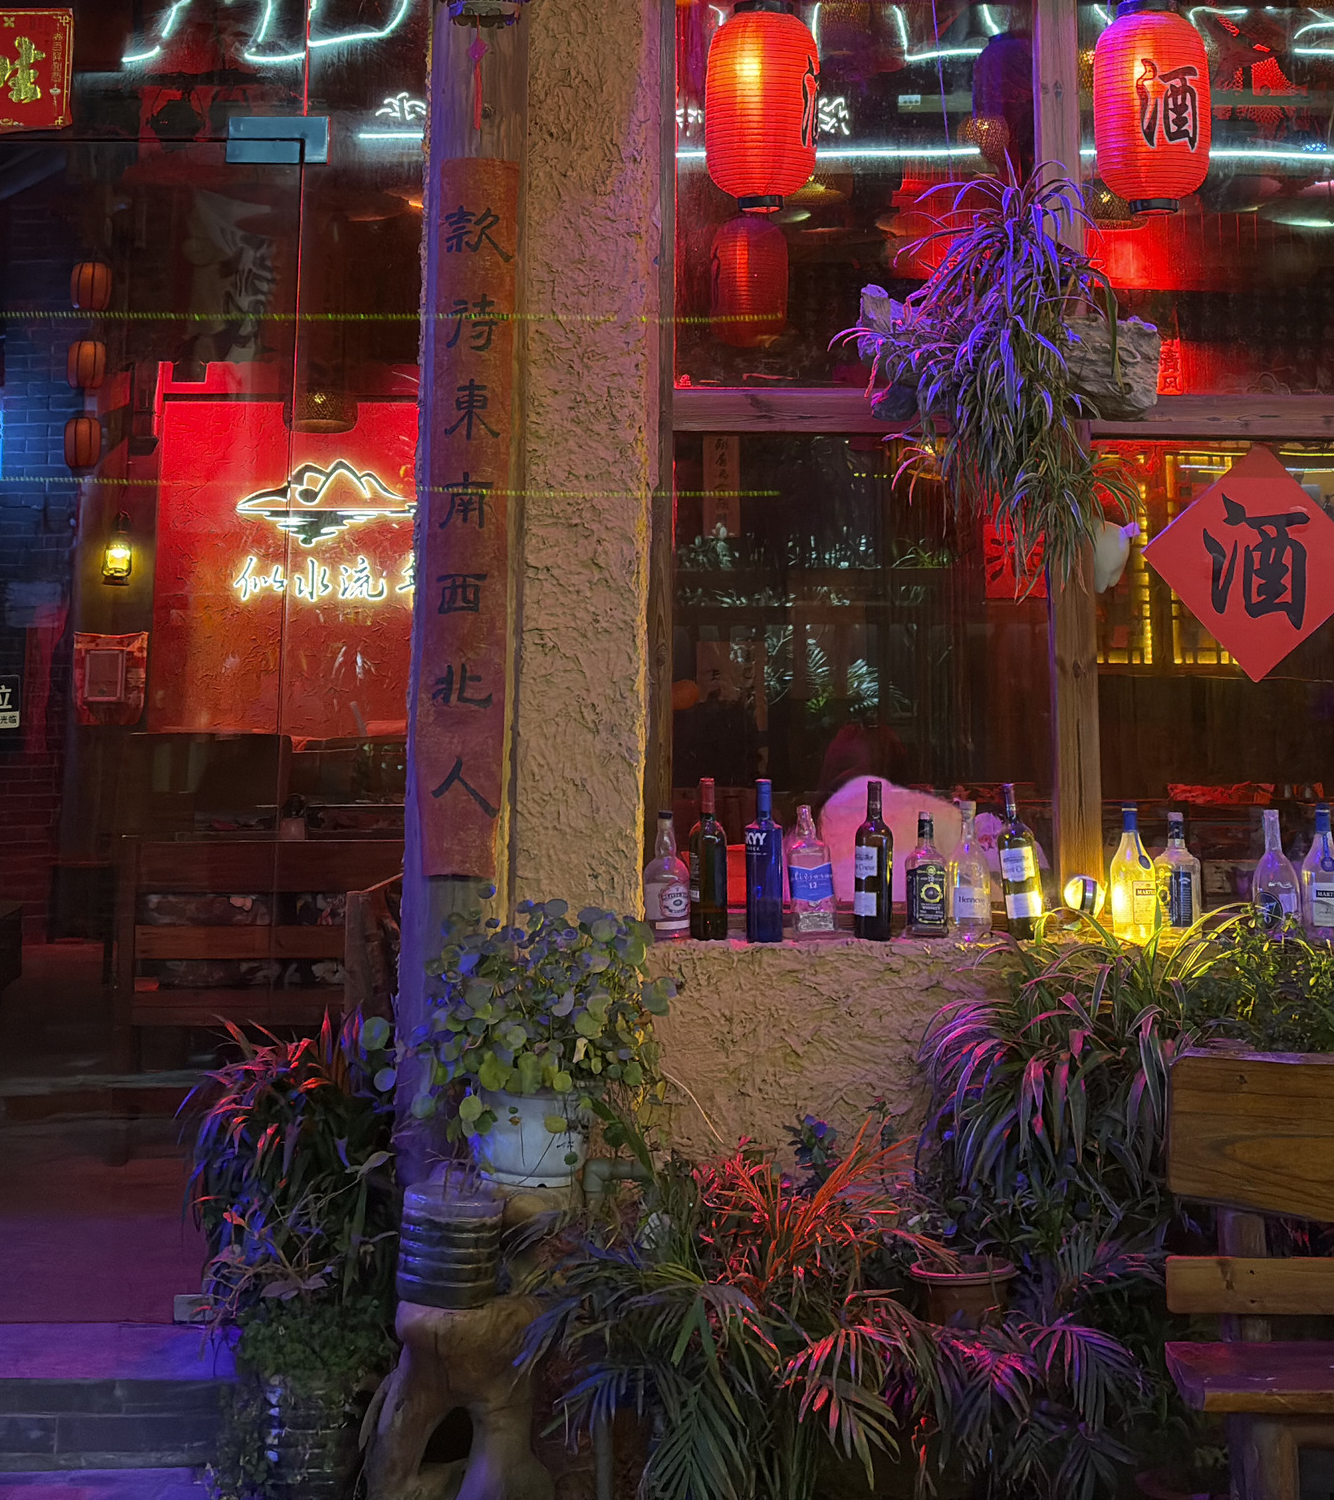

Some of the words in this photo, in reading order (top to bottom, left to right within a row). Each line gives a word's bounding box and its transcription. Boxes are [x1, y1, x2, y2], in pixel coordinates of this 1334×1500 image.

[1138, 58, 1199, 151] 酒
[431, 205, 513, 819] 款待東南西北人
[1203, 493, 1310, 631] 酒
